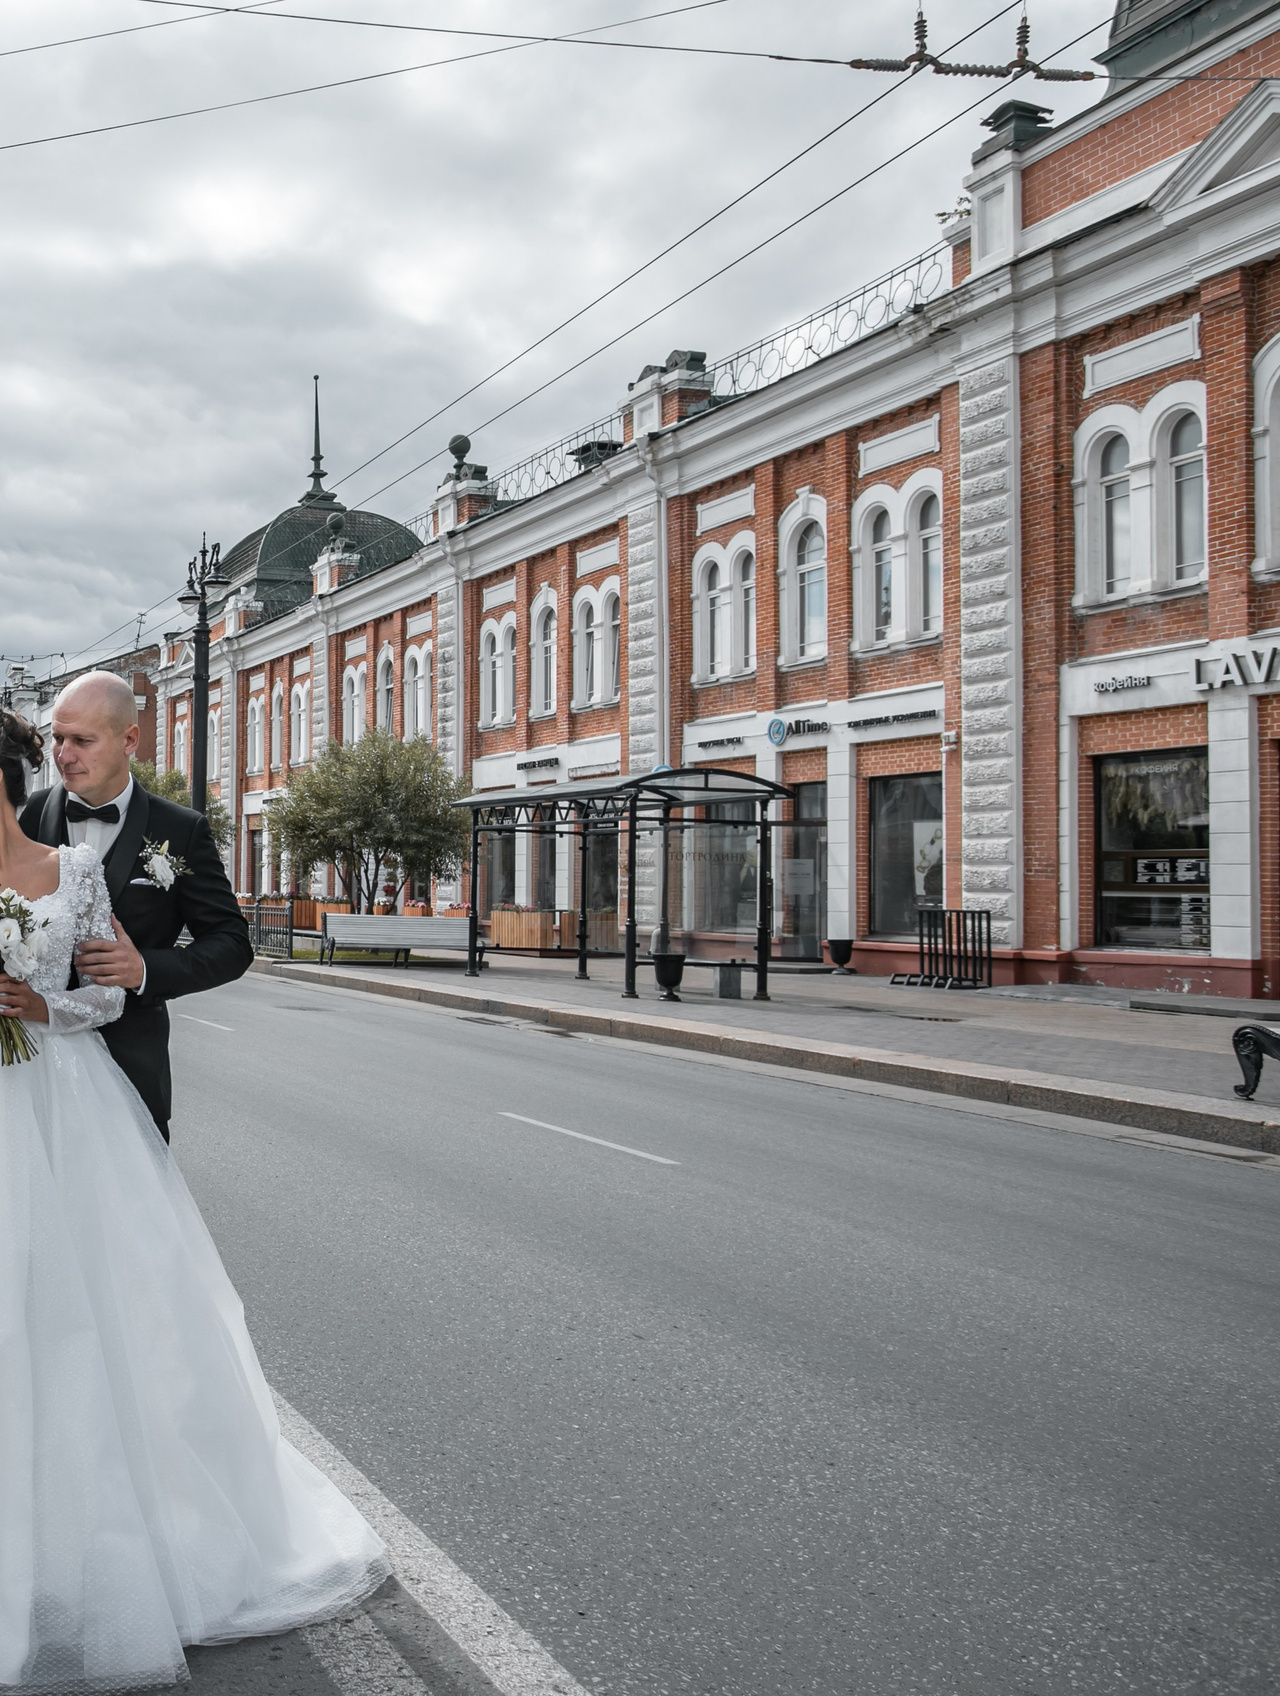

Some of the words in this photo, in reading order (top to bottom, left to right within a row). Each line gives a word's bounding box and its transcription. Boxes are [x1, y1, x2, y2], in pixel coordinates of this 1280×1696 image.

[1191, 647, 1280, 692] LAV
[1094, 676, 1150, 693] кофейня
[786, 719, 829, 736] AllTime
